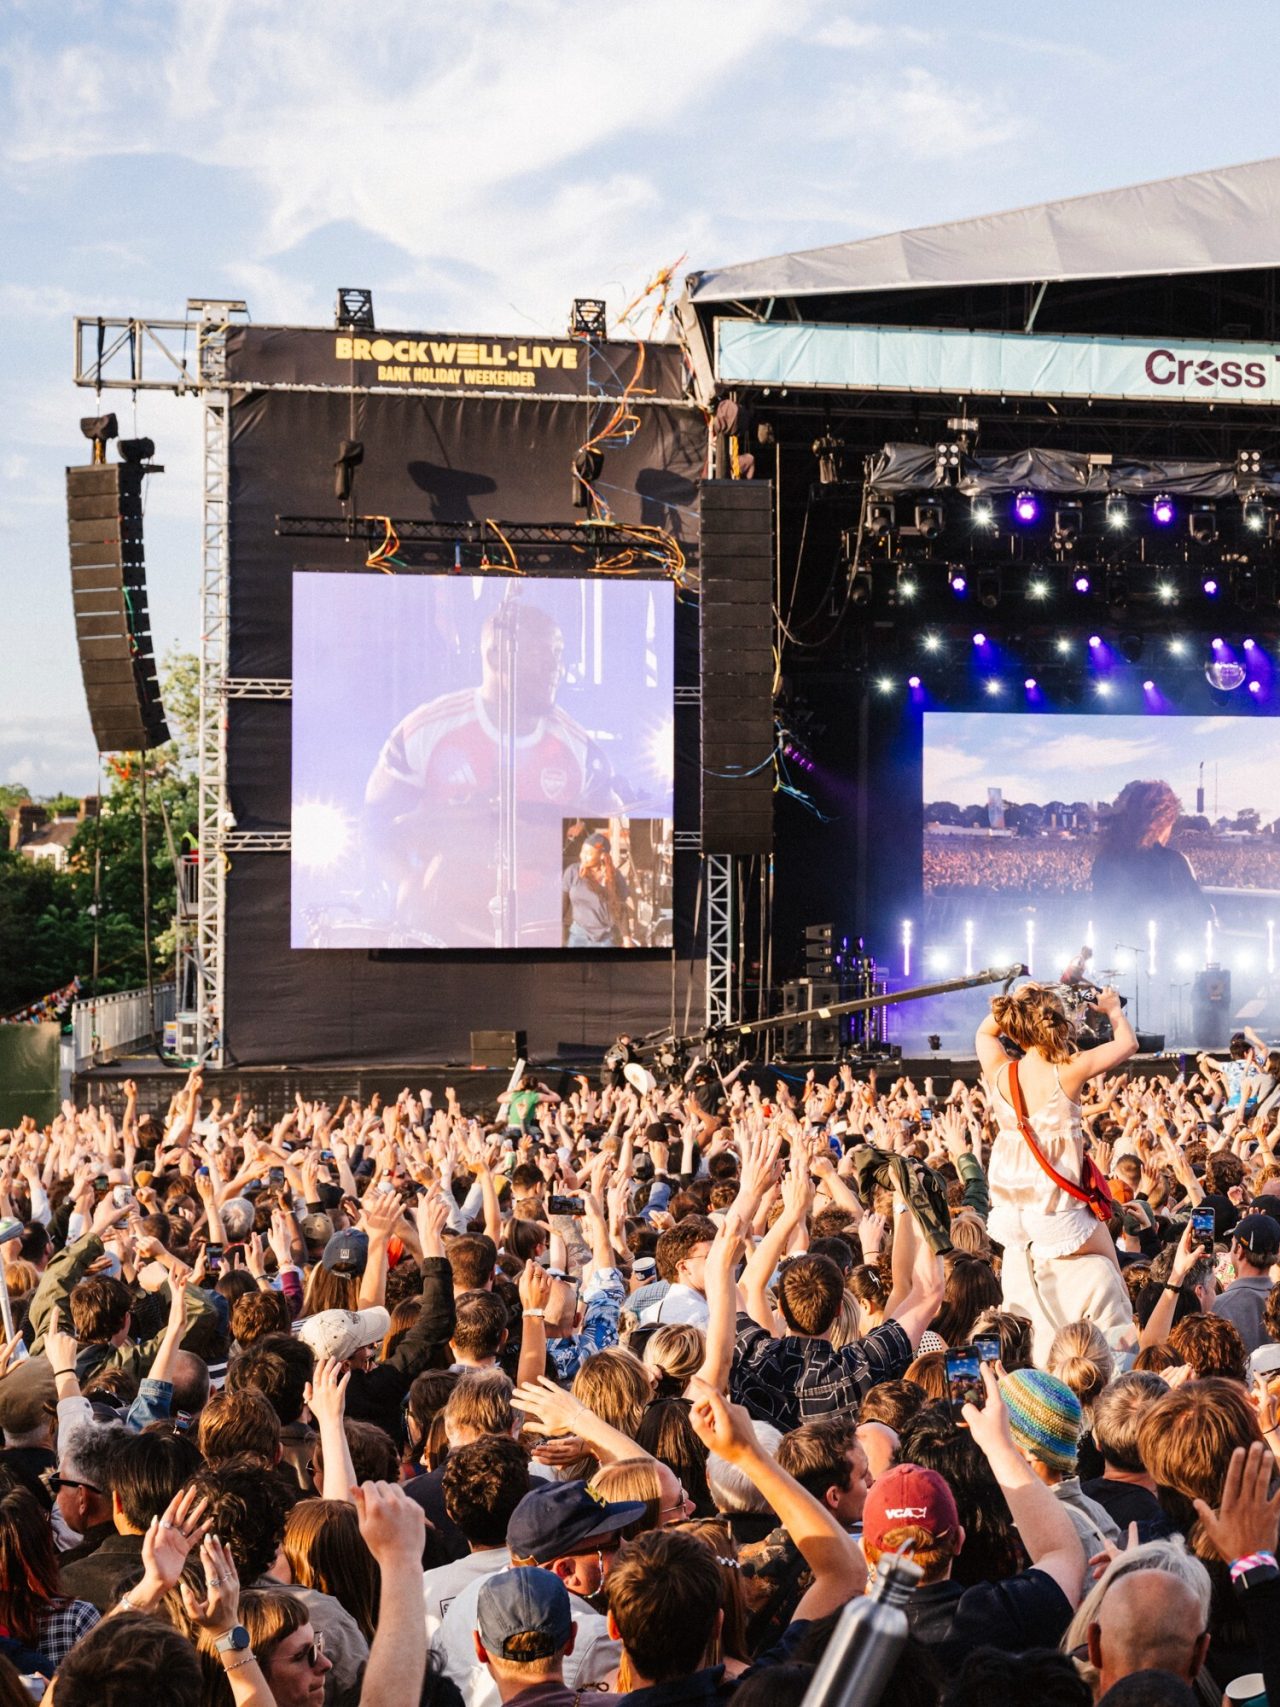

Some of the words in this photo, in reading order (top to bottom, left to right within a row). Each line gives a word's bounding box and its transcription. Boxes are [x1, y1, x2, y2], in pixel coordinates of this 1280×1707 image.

[377, 365, 411, 382] BANK
[413, 367, 462, 384] HOLIDAY
[464, 369, 536, 387] WEEKENDER
[1144, 349, 1267, 388] Cross
